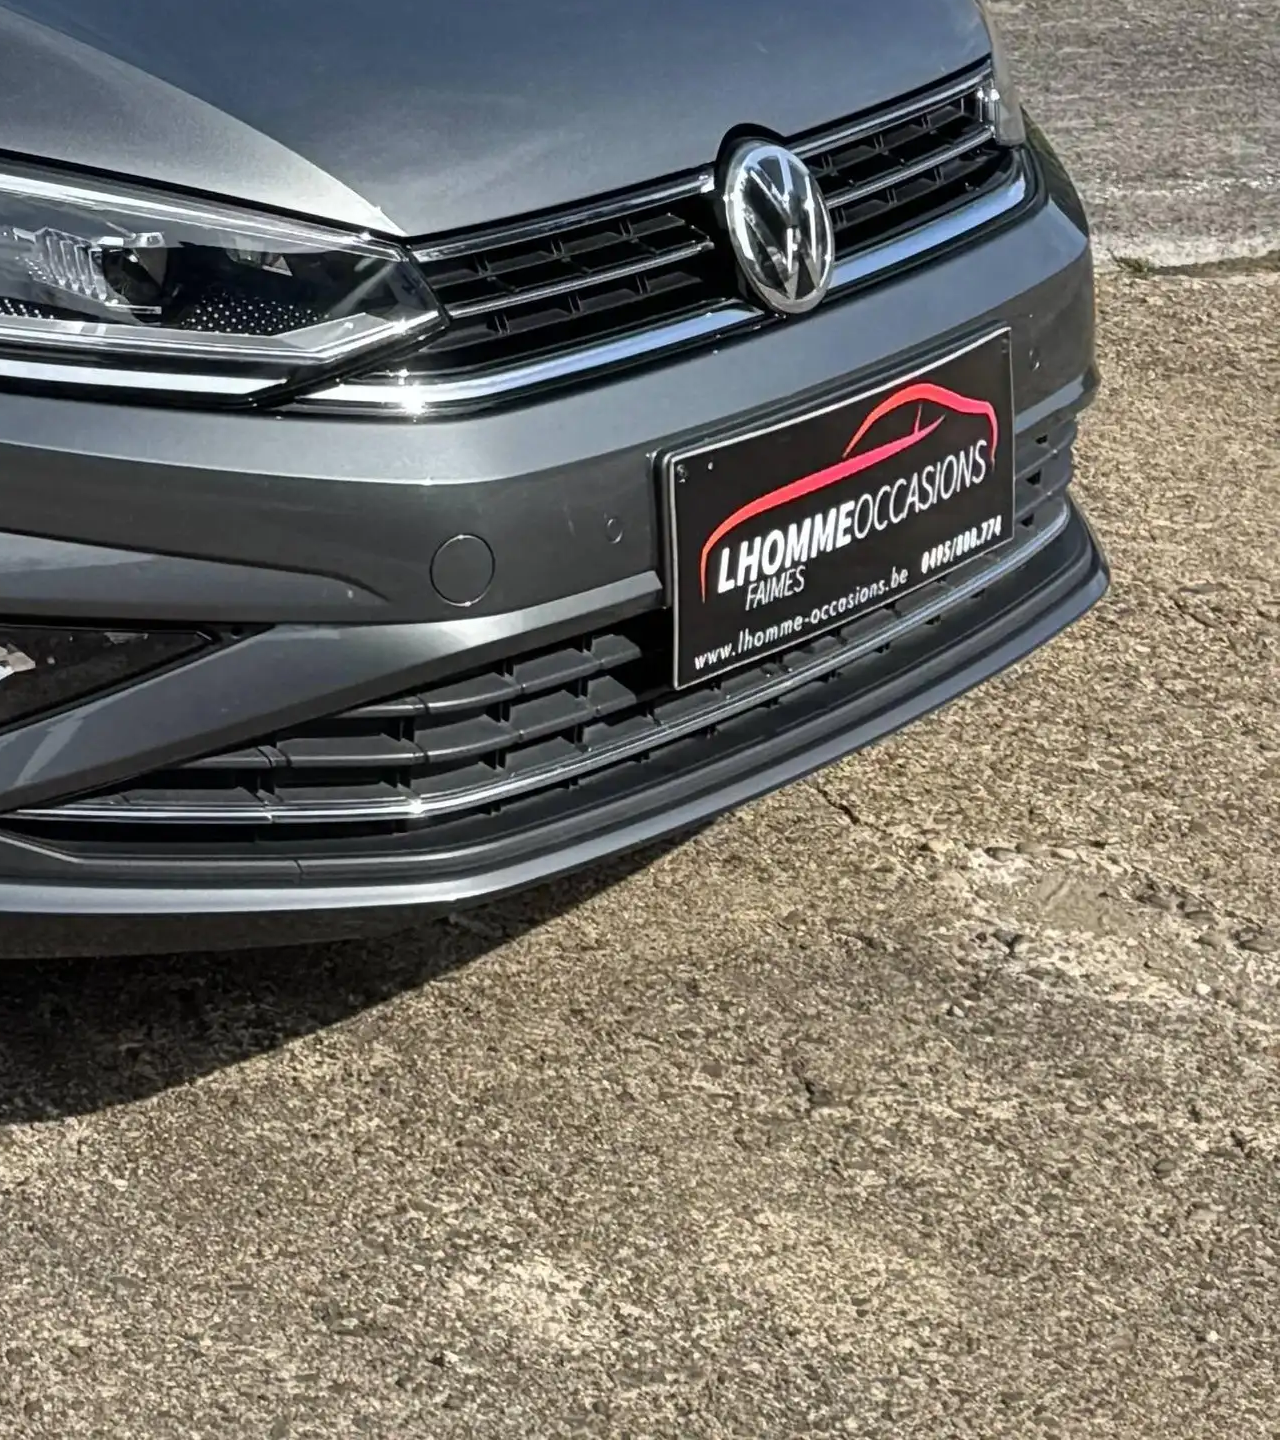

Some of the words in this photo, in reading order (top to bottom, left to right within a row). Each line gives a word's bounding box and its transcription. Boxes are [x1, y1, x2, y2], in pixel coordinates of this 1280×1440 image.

[726, 146, 834, 313] VW
[694, 568, 909, 670] www.lhomme-occasions.be
[745, 565, 806, 611] FAIMES
